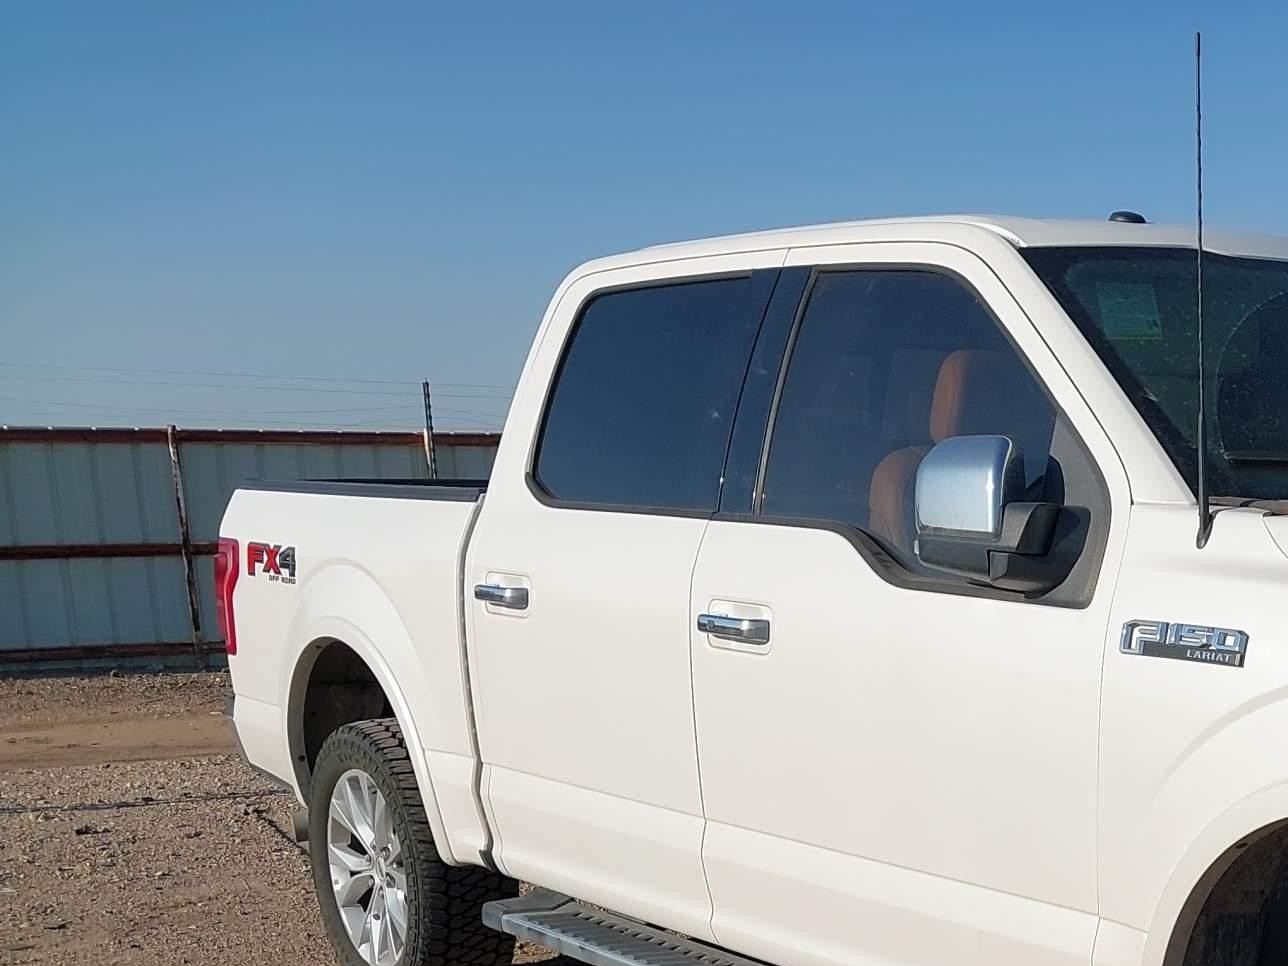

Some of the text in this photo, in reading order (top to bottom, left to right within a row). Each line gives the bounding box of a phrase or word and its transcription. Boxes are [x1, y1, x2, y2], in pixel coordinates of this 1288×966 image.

[247, 541, 296, 577] FX4
[268, 574, 280, 582] OFF
[1186, 648, 1232, 663] LARIAT
